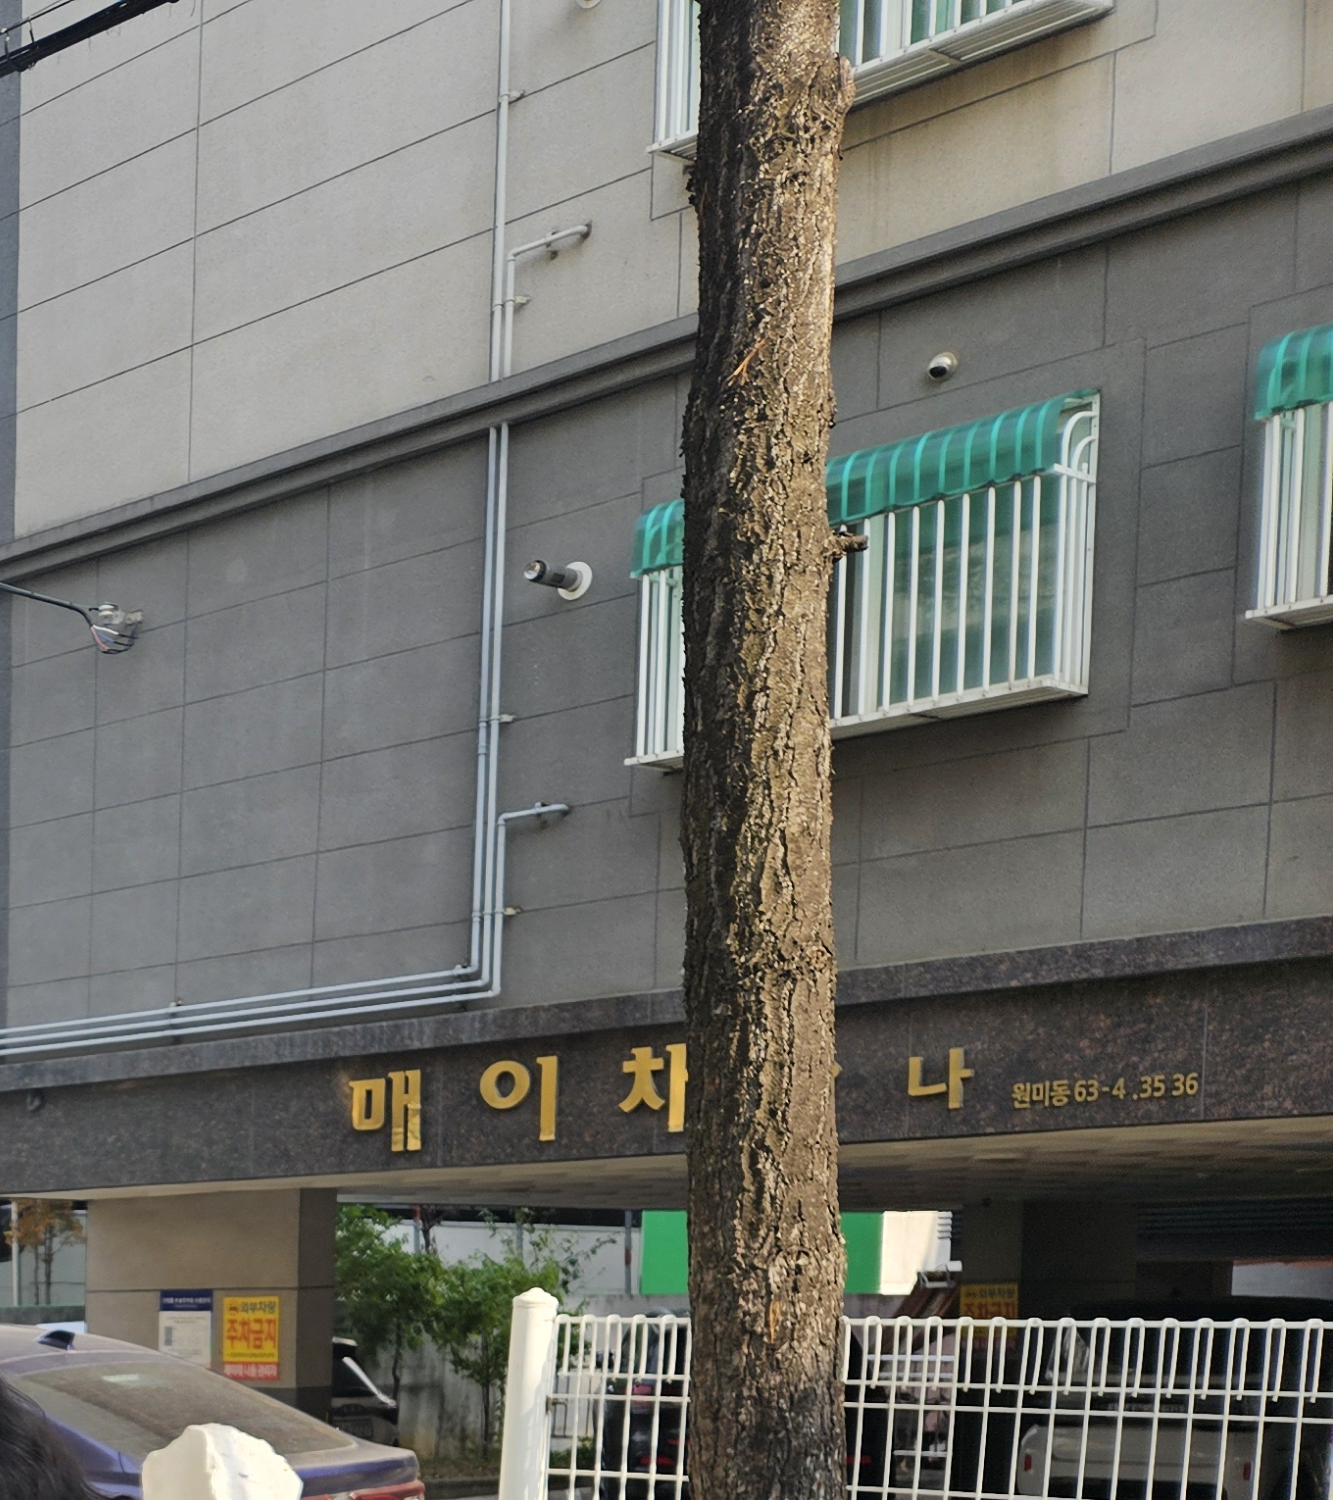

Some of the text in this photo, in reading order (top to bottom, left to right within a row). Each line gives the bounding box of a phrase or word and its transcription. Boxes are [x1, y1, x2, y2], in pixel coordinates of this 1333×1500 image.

[1012, 1079, 1071, 1109] 원미동
[1172, 1072, 1199, 1096] 36
[226, 1317, 277, 1349] 주차금지
